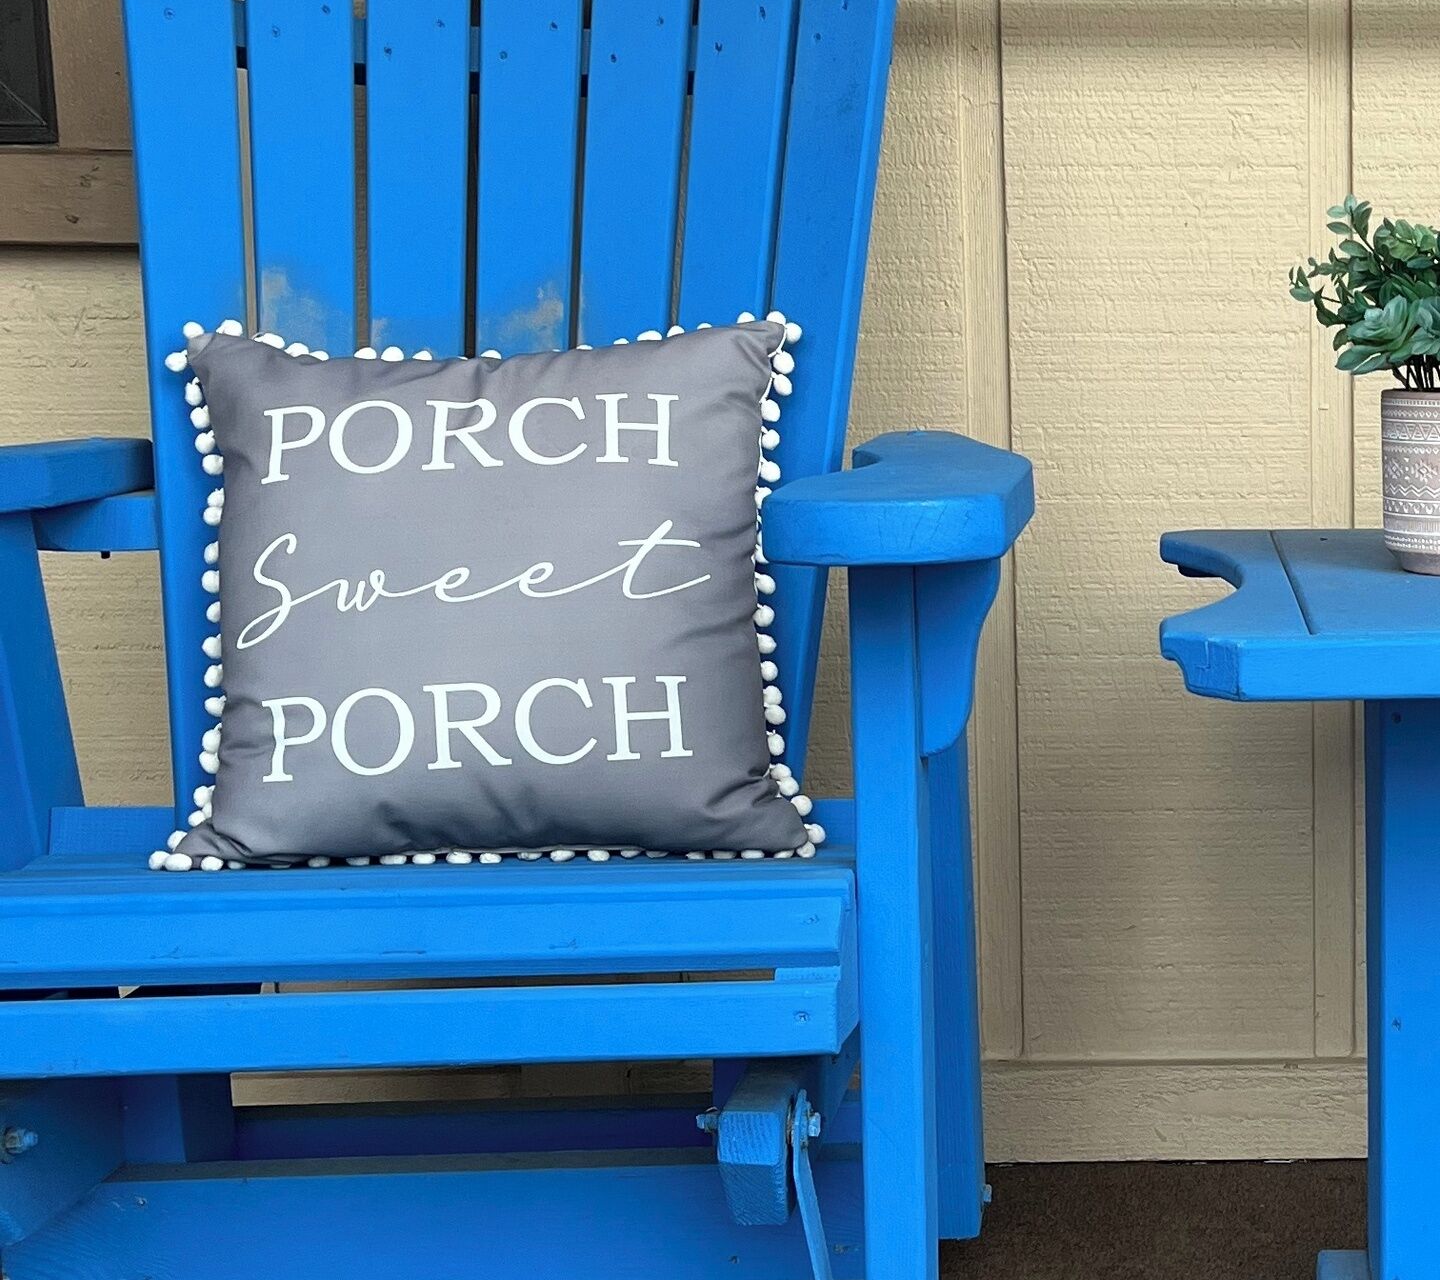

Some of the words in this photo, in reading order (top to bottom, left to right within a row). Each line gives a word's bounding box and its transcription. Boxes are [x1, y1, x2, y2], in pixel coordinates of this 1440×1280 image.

[261, 392, 679, 485] PORCH
[237, 519, 711, 650] Sweet
[261, 674, 694, 784] PORCH
